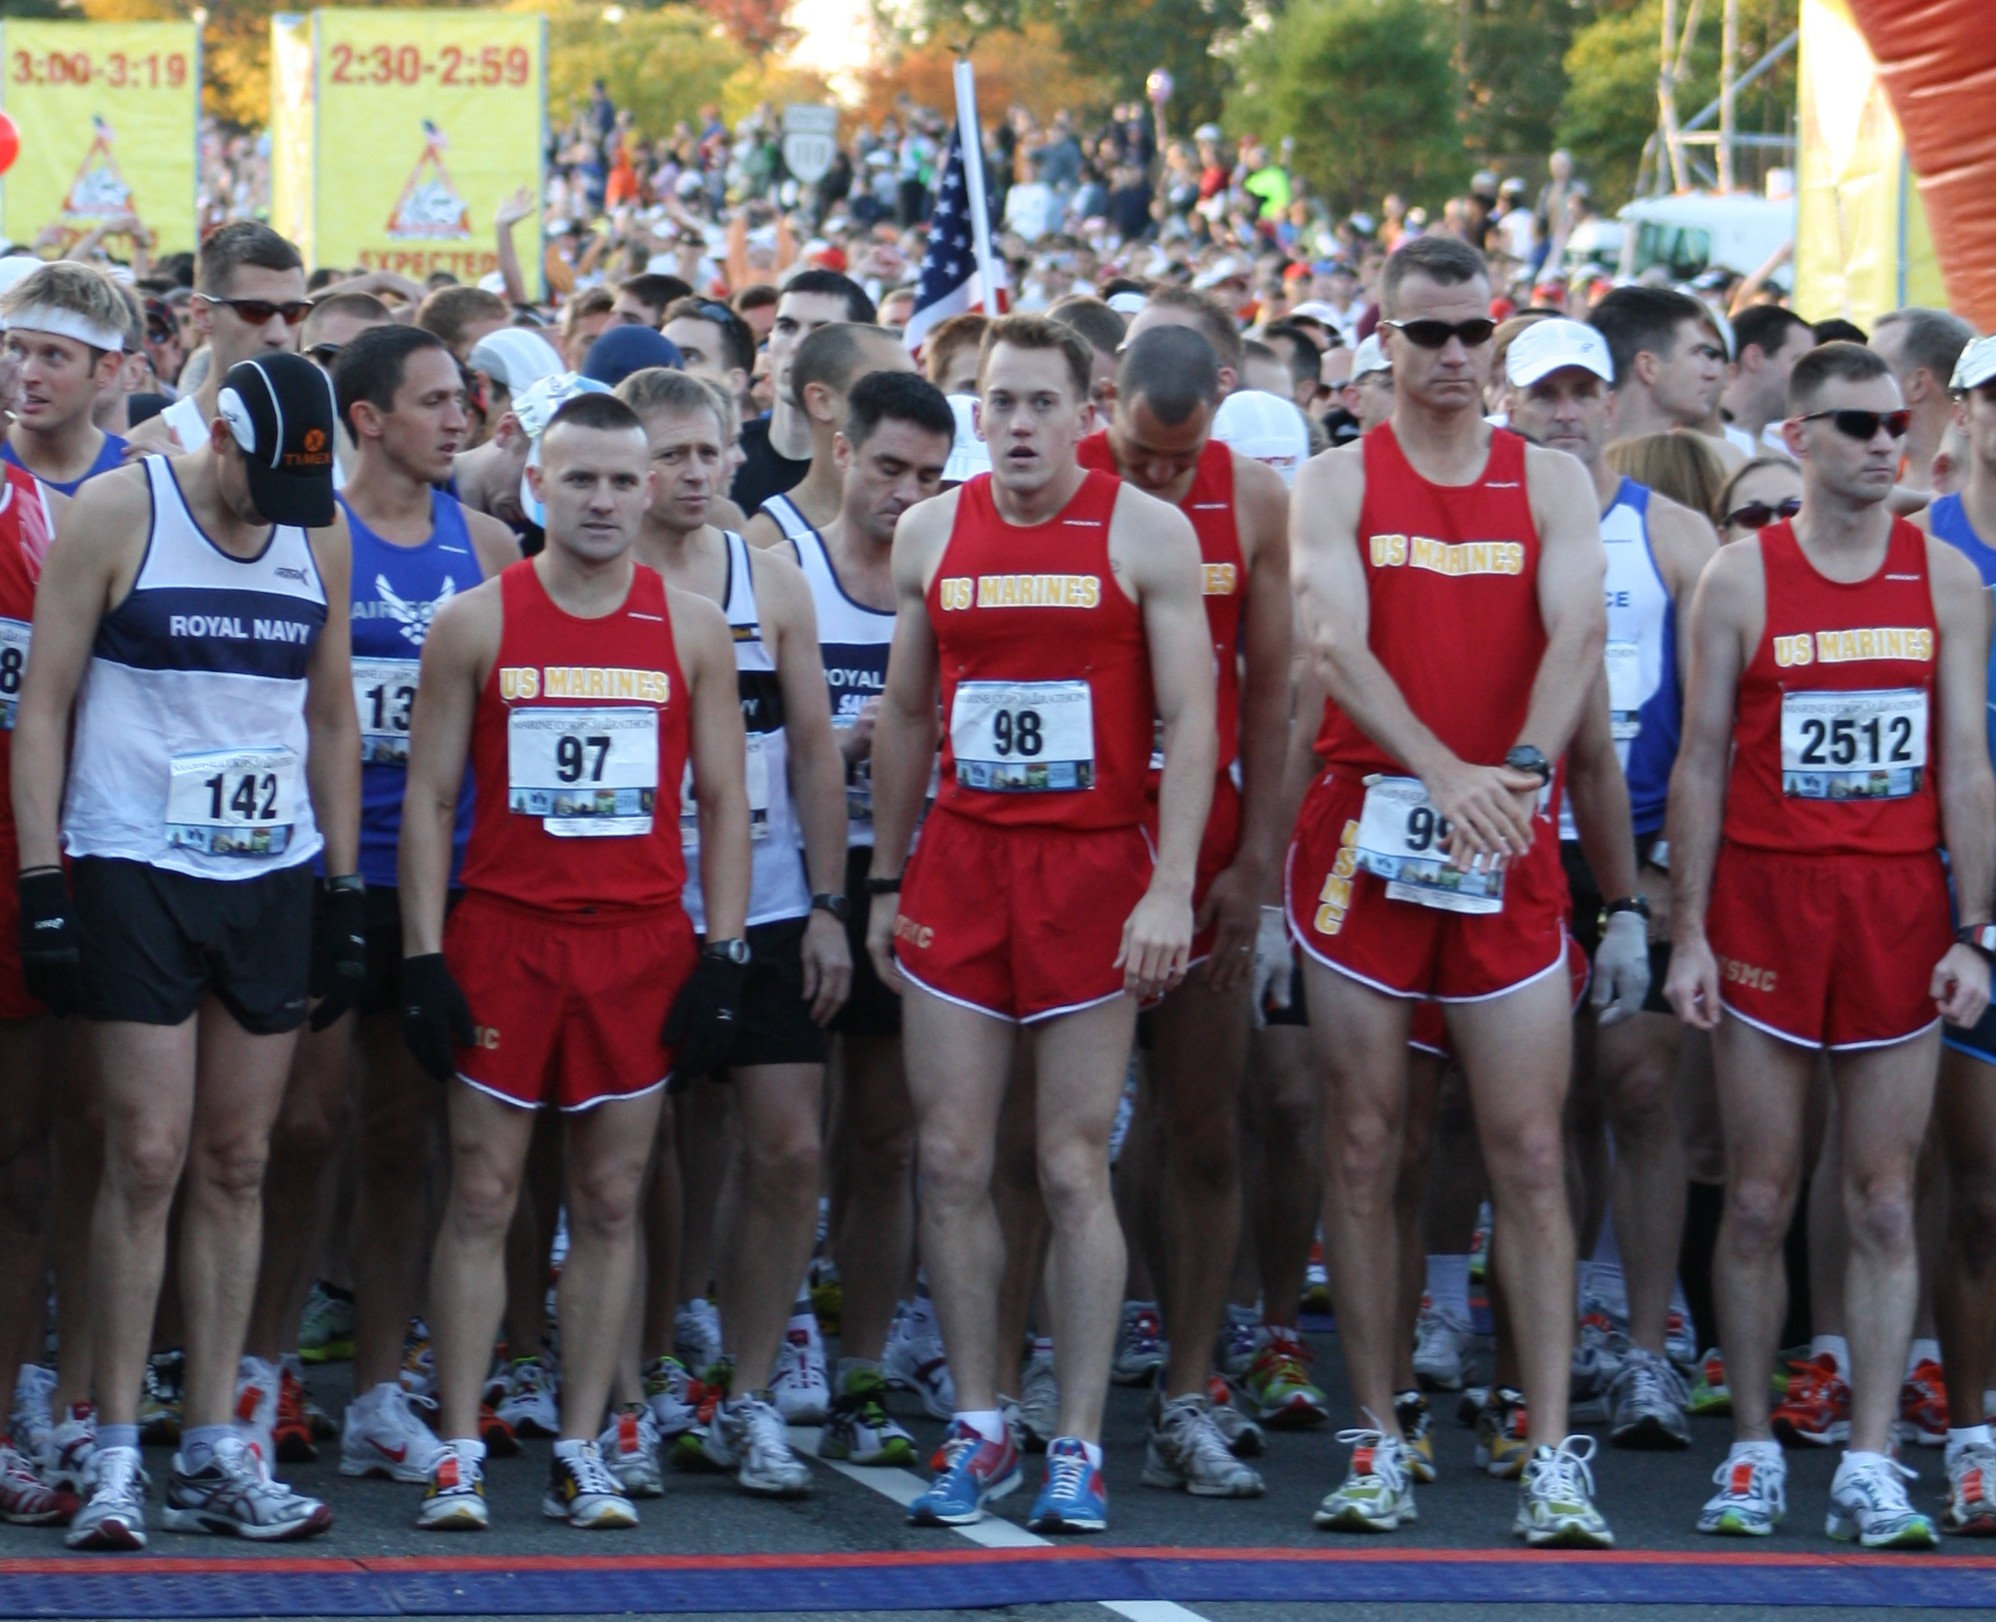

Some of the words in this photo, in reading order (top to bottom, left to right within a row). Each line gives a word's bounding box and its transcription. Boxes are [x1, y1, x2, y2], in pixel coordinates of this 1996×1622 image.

[13, 50, 187, 88] 3:00-3:19
[331, 44, 529, 86] 2:30-2:59
[1369, 534, 1408, 568] US
[1408, 536, 1524, 577] MARINES
[940, 577, 974, 611] US
[976, 574, 1100, 609] MARINES
[169, 615, 249, 639] ROYAL
[253, 618, 311, 645] NAVY
[1773, 633, 1814, 668] US
[1815, 627, 1934, 663] MARINES
[499, 667, 540, 701] US
[543, 666, 671, 704] MARINES
[993, 709, 1043, 757] 98
[1800, 715, 1912, 765] 2512
[556, 735, 611, 783] 97
[204, 772, 278, 820] 142
